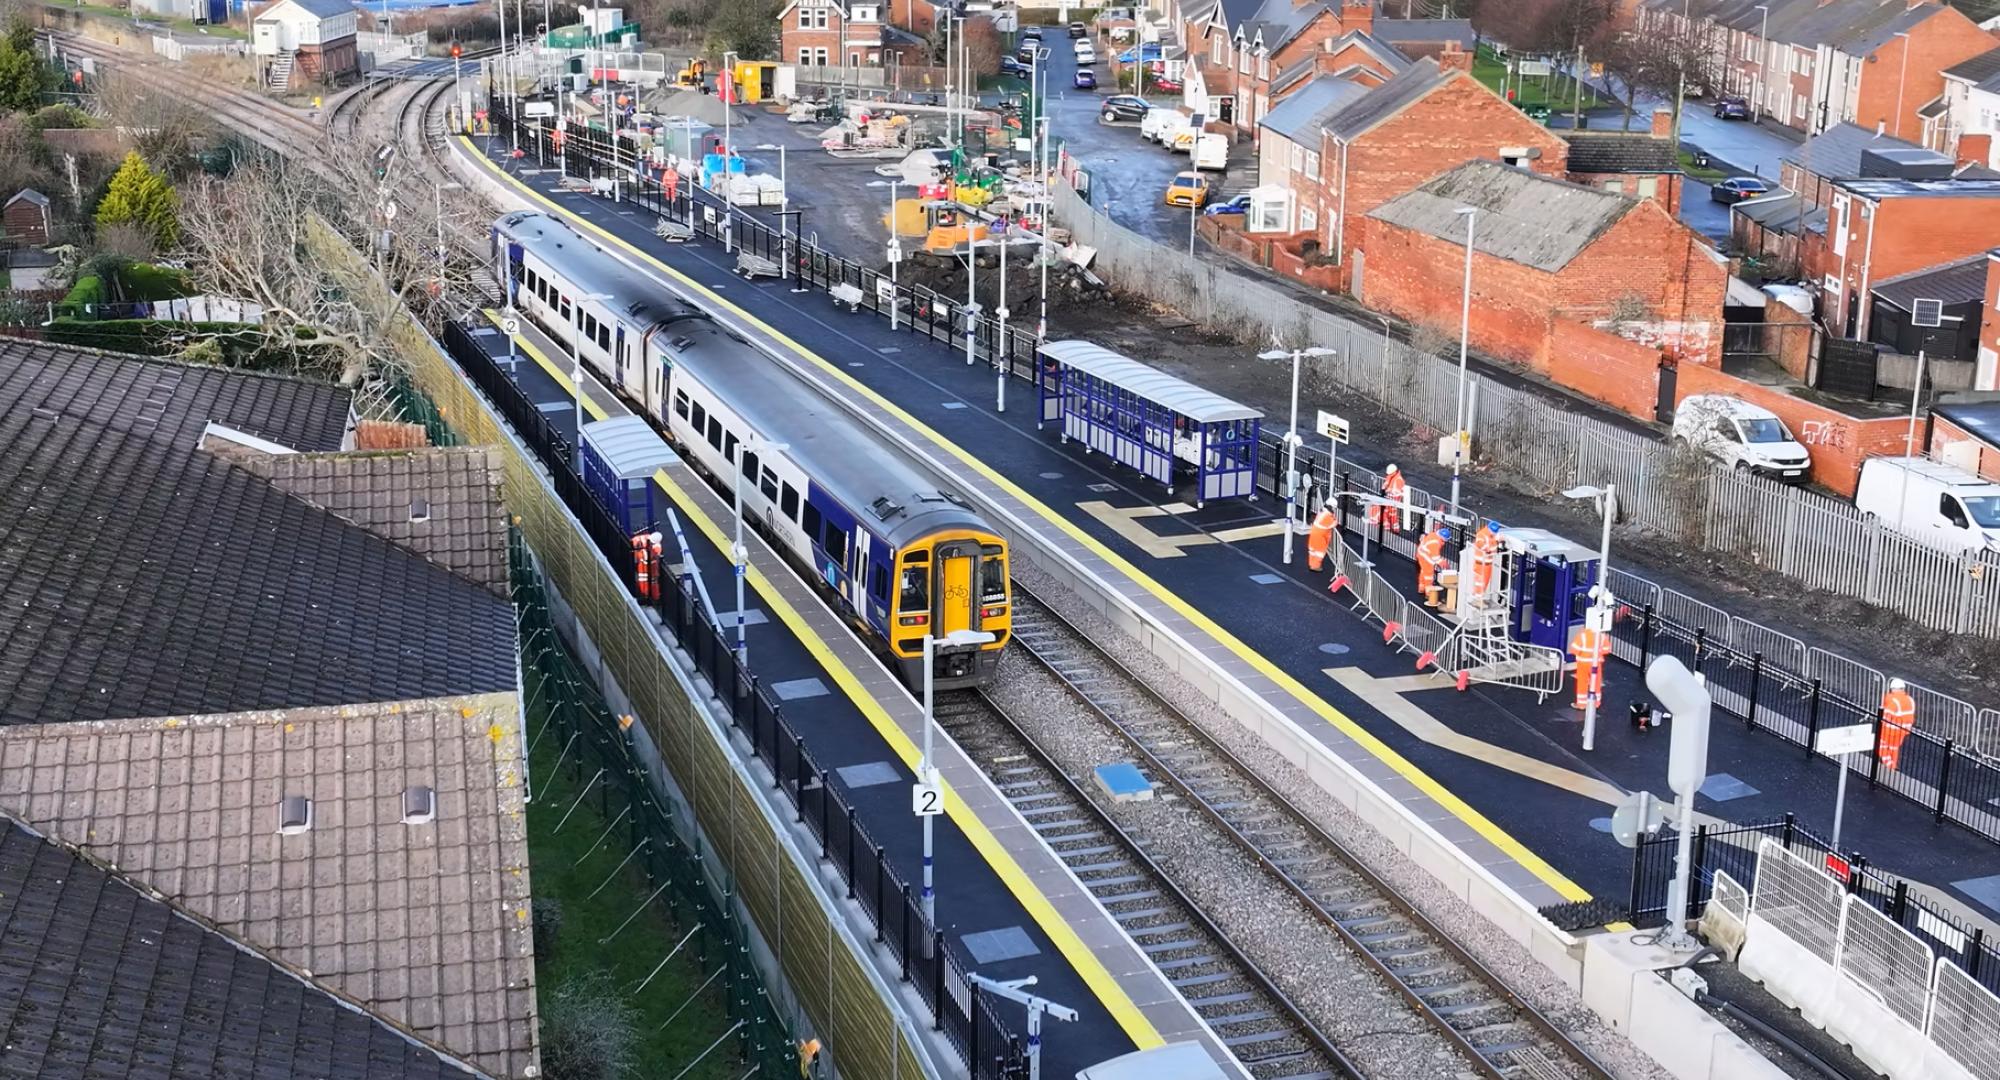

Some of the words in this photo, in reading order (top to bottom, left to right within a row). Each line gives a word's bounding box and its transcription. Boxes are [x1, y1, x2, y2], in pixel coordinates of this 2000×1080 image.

[507, 320, 516, 332] 2
[1599, 612, 1604, 629] 1
[922, 791, 937, 812] 2
